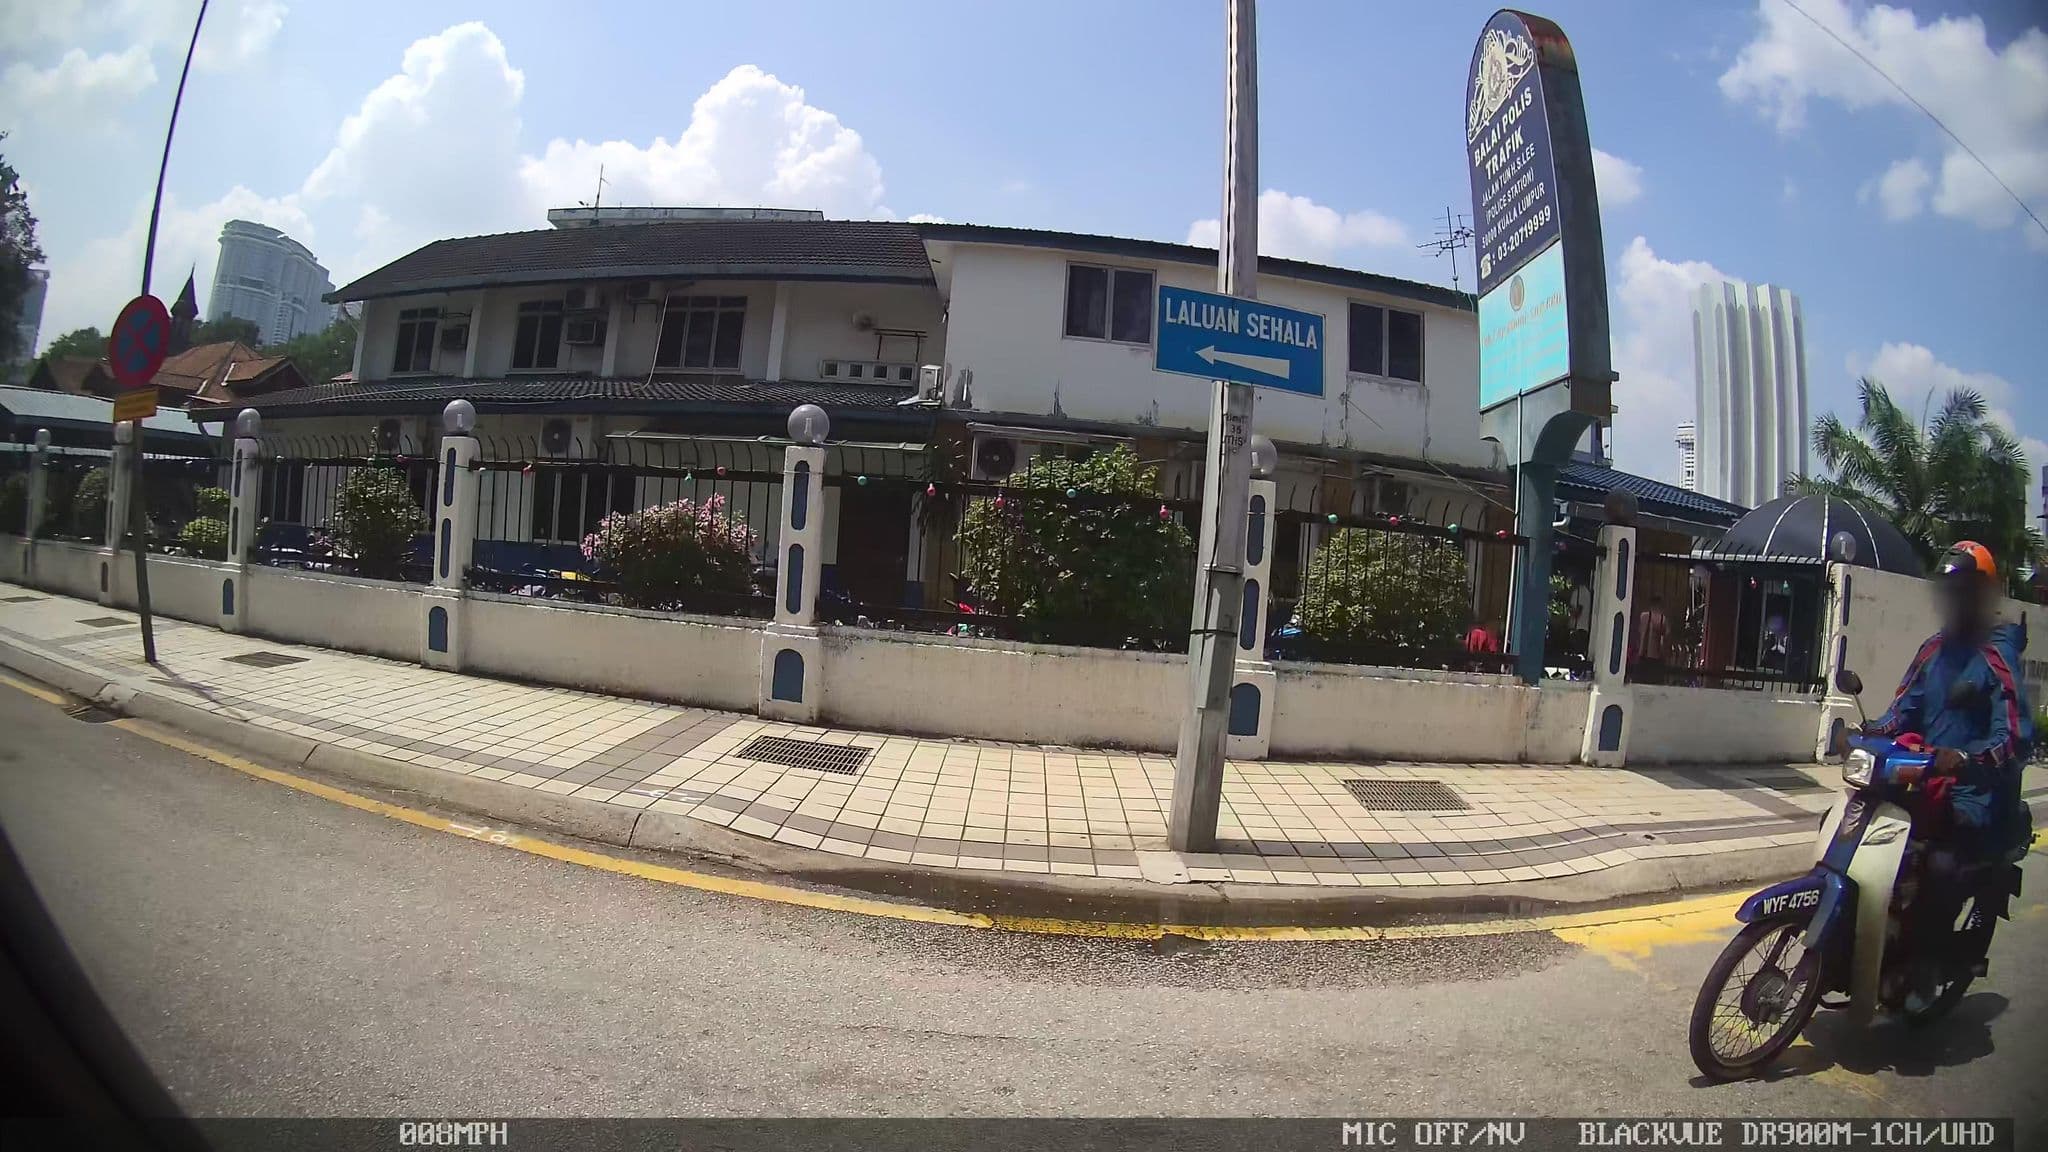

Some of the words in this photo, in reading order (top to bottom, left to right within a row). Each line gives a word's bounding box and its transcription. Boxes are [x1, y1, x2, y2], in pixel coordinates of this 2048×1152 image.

[1474, 123, 1501, 167] BALAI
[1502, 86, 1532, 133] POLIS
[1485, 125, 1523, 180] TRAFIK
[1482, 179, 1500, 206] JALAN
[1497, 207, 1518, 234] KUALA
[1518, 182, 1545, 215] LUMPUR
[1165, 297, 1240, 334] LALUAN
[1246, 313, 1318, 350] SEHALA
[1763, 895, 1789, 915] WYF
[1788, 889, 1820, 909] 4756
